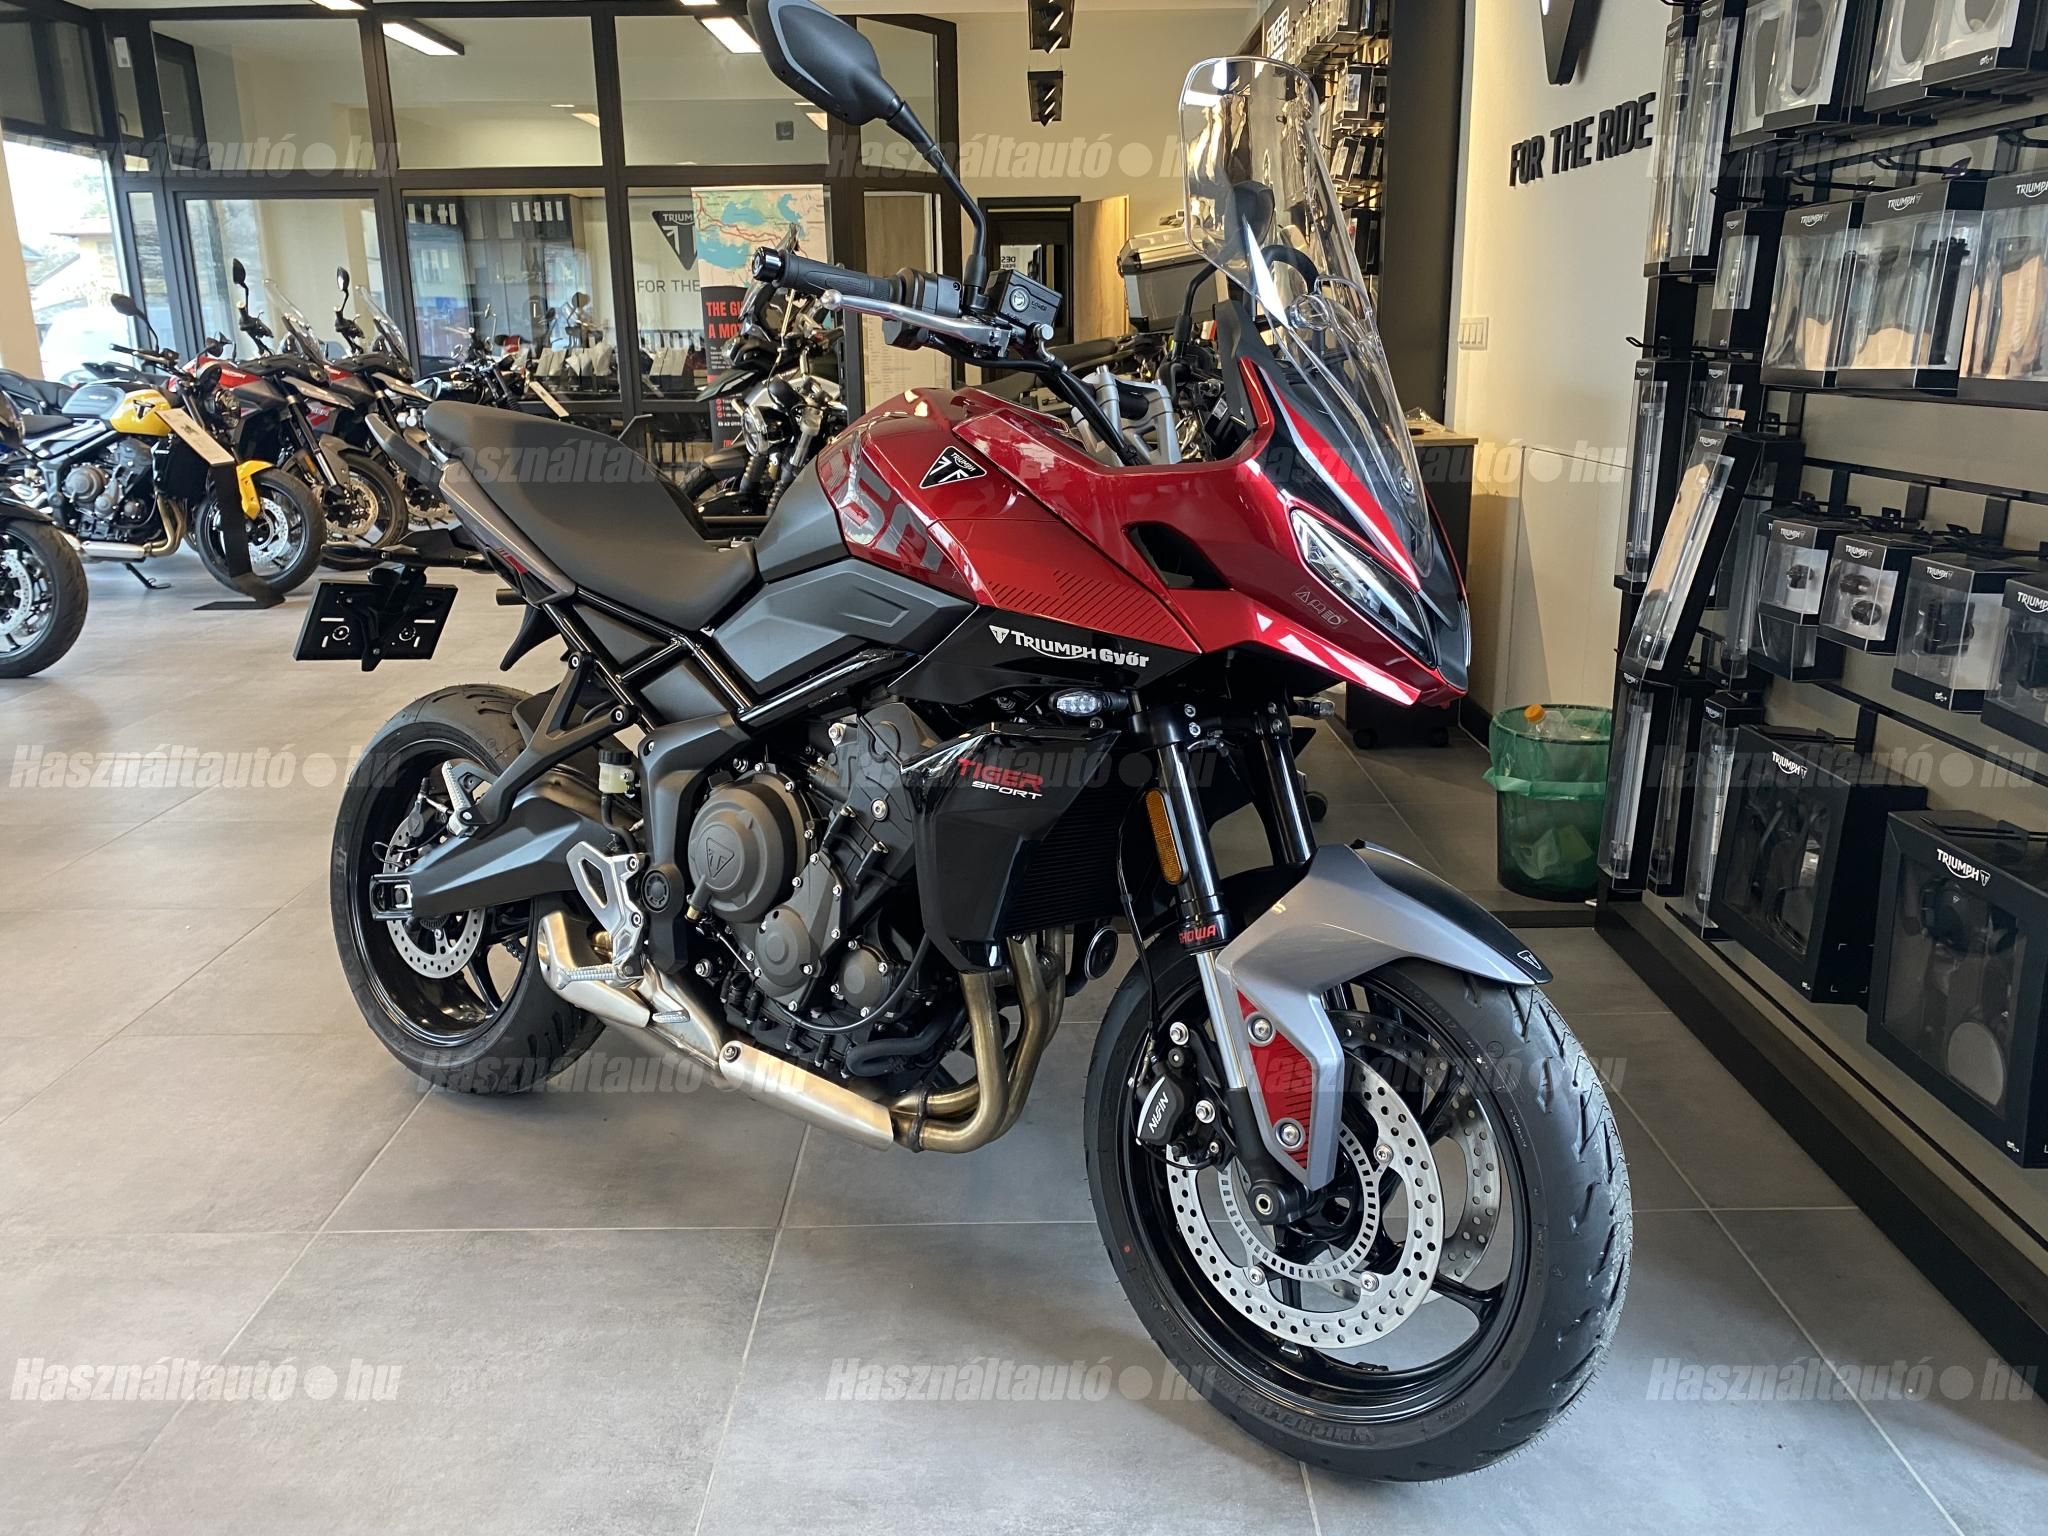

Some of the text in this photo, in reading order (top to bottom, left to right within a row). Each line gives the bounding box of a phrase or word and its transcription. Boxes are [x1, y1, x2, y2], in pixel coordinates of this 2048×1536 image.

[1509, 92, 1656, 187] FOR THE RIDE
[637, 280, 666, 293] FOR
[705, 302, 727, 317] THE
[708, 323, 717, 339] A
[950, 452, 976, 473] TRIUMPH
[1010, 630, 1097, 660] TRIUMPH
[1772, 751, 1801, 775] TRIUMPH
[957, 757, 1044, 793] TIGER
[971, 780, 1043, 800] SPORT
[1937, 849, 1979, 881] TRIUMPH
